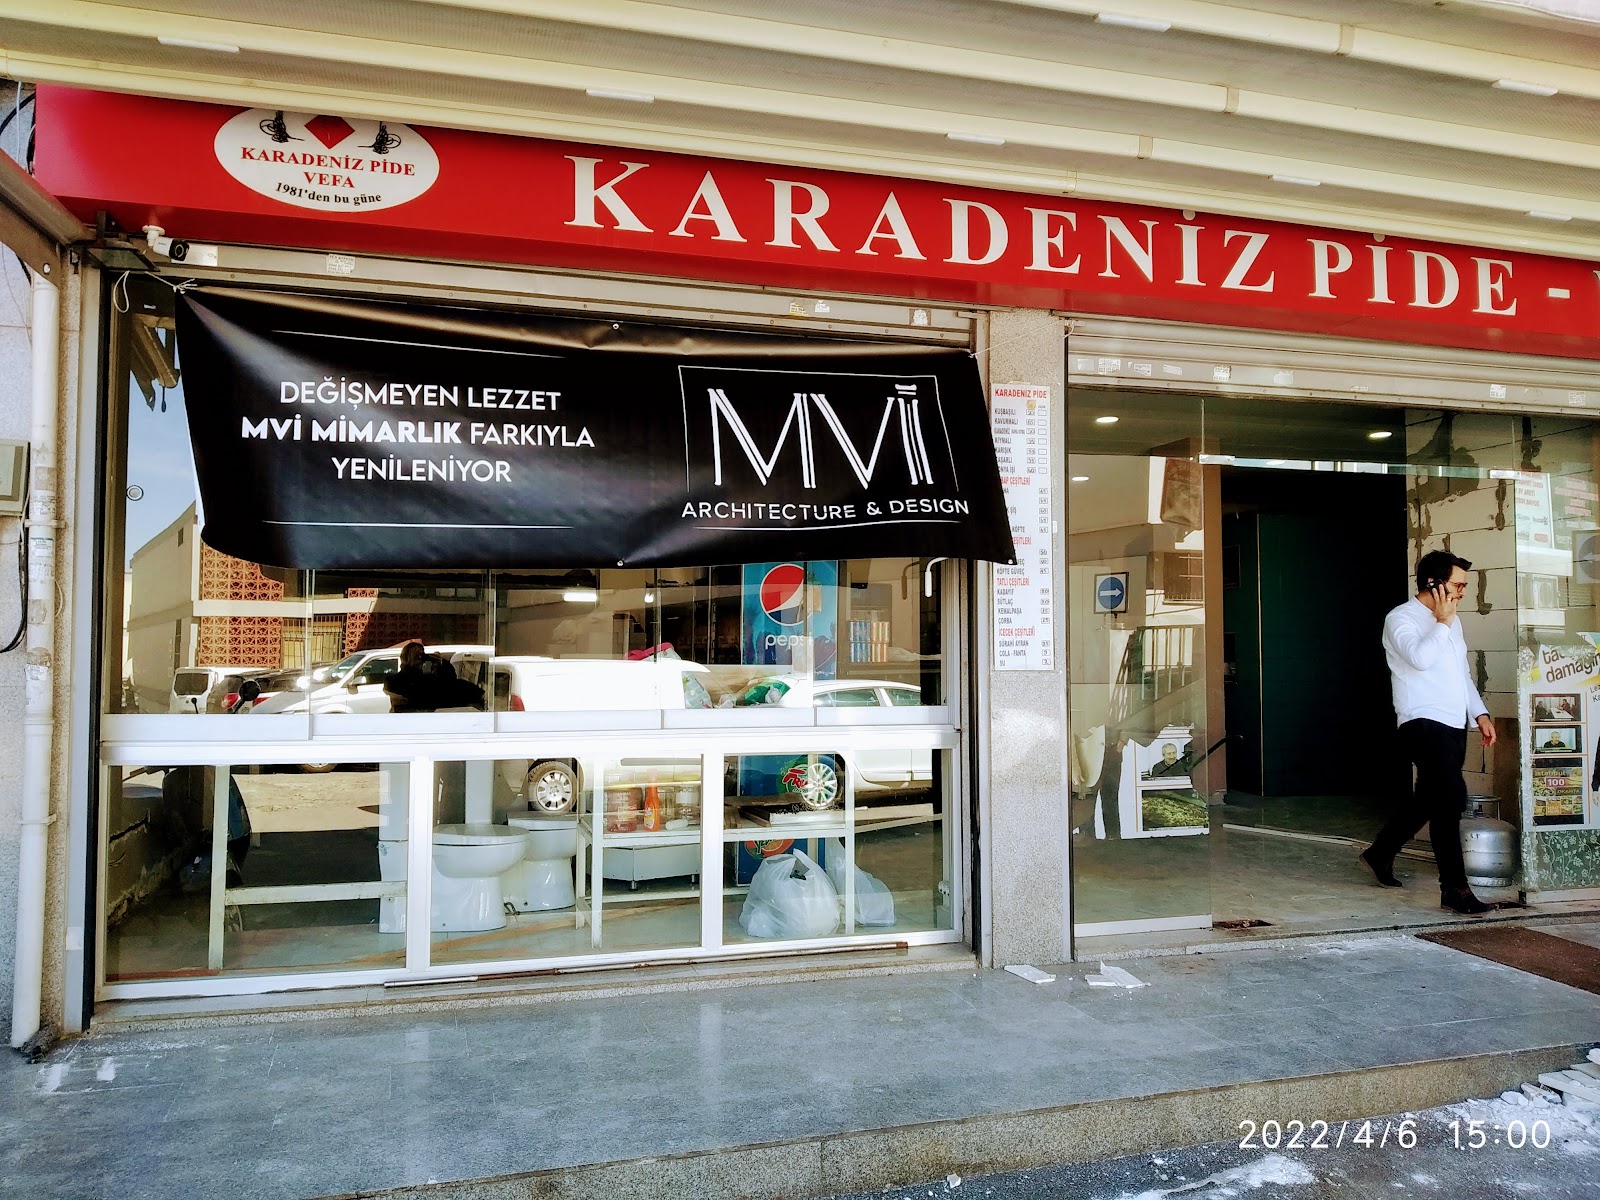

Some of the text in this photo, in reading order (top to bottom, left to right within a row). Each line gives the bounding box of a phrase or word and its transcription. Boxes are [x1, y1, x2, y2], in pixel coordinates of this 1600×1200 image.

[240, 147, 416, 176] KARADENİZ PİDE
[303, 171, 356, 188] VEFA
[275, 182, 383, 206] 1981'den bu güne
[564, 155, 1275, 292] KARADENİZ
[1306, 233, 1518, 316] PİDE
[280, 376, 562, 411] DEĞİŞMEYEN LEZZET
[1032, 390, 1047, 398] PİDE
[241, 414, 596, 447] MVİ MİMARLIK FARKIYLA
[331, 454, 513, 483] YENİLENİYOR
[997, 457, 1013, 465] AŞARLI
[681, 499, 970, 521] ARCHITECTURE & DESIGN
[1012, 536, 1032, 547] EŞİTLERİ
[765, 632, 814, 650] pepsi
[1547, 778, 1565, 786] 100
